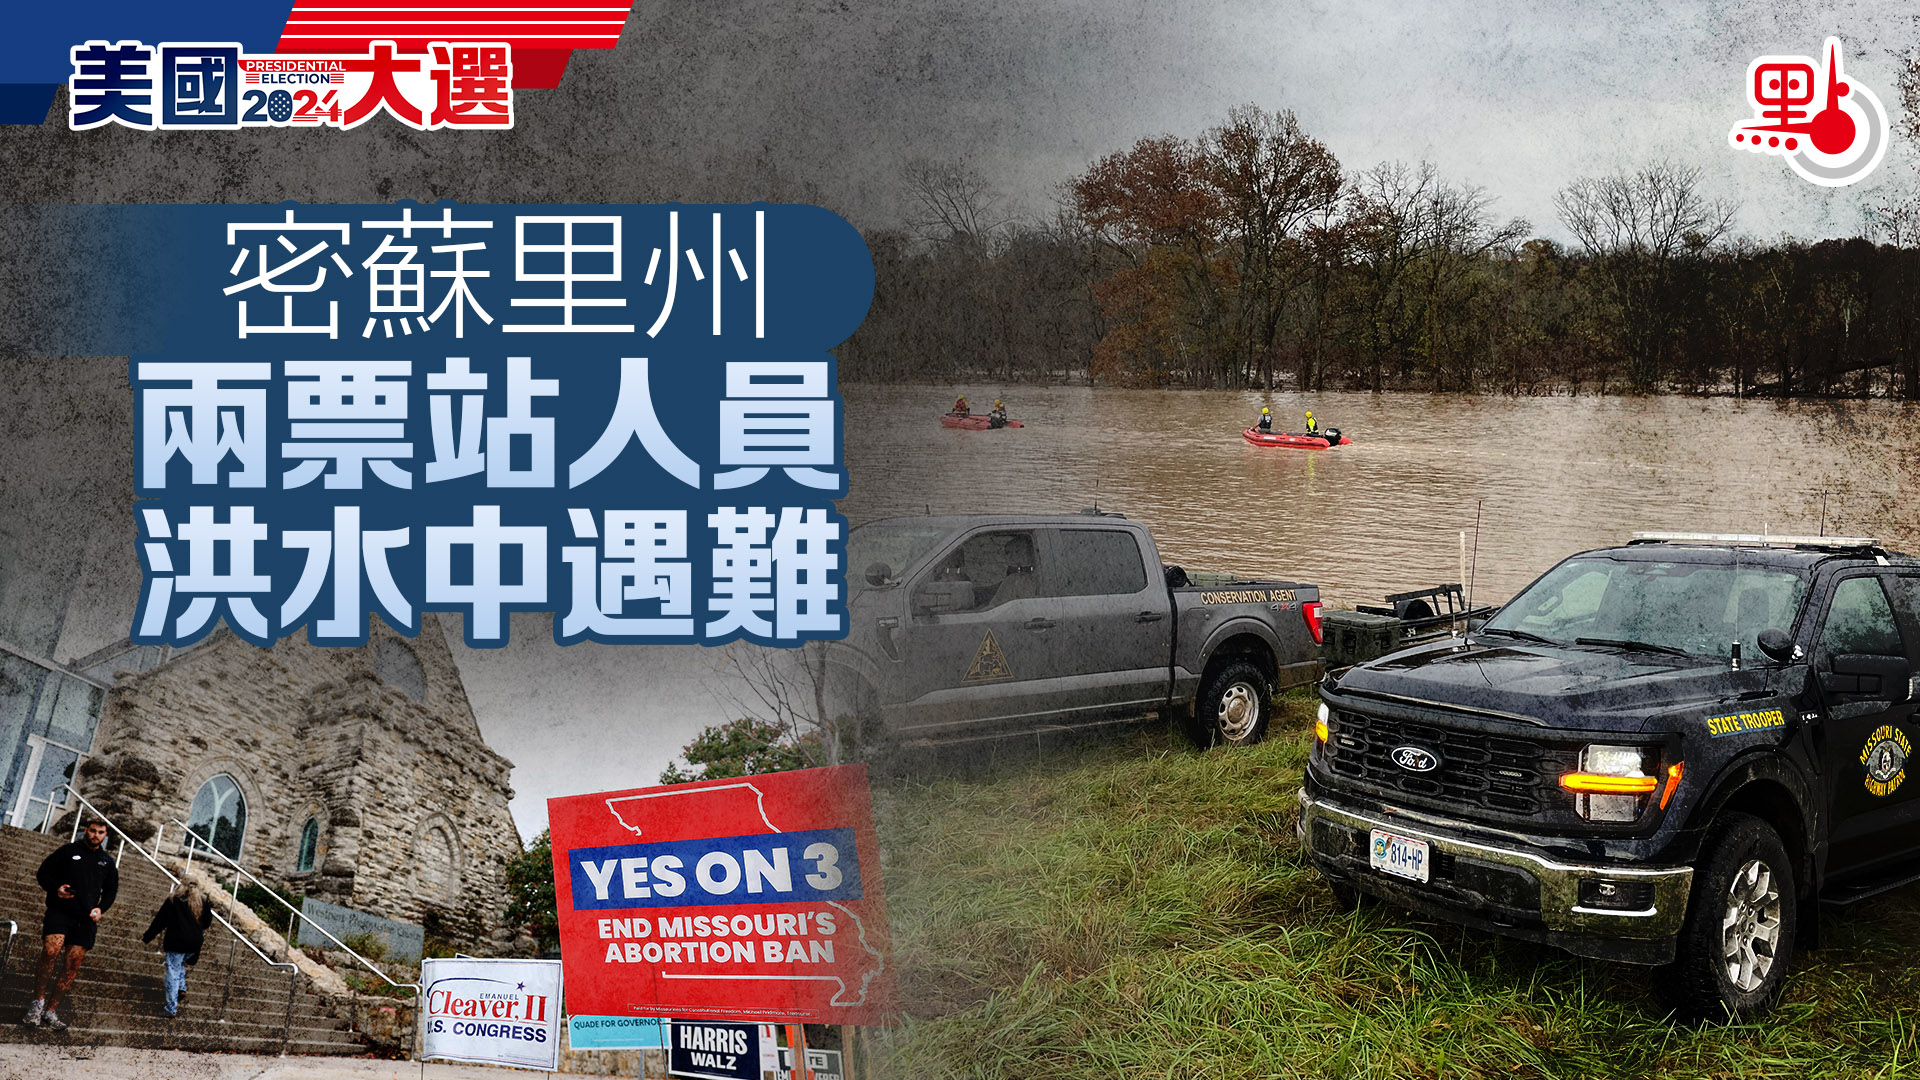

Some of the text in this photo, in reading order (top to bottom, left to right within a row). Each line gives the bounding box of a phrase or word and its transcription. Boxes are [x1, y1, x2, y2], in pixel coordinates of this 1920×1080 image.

[1200, 589, 1298, 605] CONSERVATION AGENT
[1707, 715, 1742, 735] STATE
[1740, 710, 1785, 730] TROOPER
[1860, 725, 1912, 765] MISSOURI STATE
[1391, 843, 1423, 870] 814-HP
[580, 842, 843, 900] YES ON 3
[598, 911, 837, 939] END MISSOURI'S
[605, 940, 836, 963] ABORTION BAN
[429, 990, 549, 1022] Cleaver, II
[479, 992, 519, 1000] EMANUEL
[453, 1022, 547, 1043] CONGRESS
[574, 1020, 600, 1029] QUADE
[601, 1019, 616, 1027] FOR
[680, 1025, 748, 1055] HARRIS
[690, 1052, 737, 1070] WALZ
